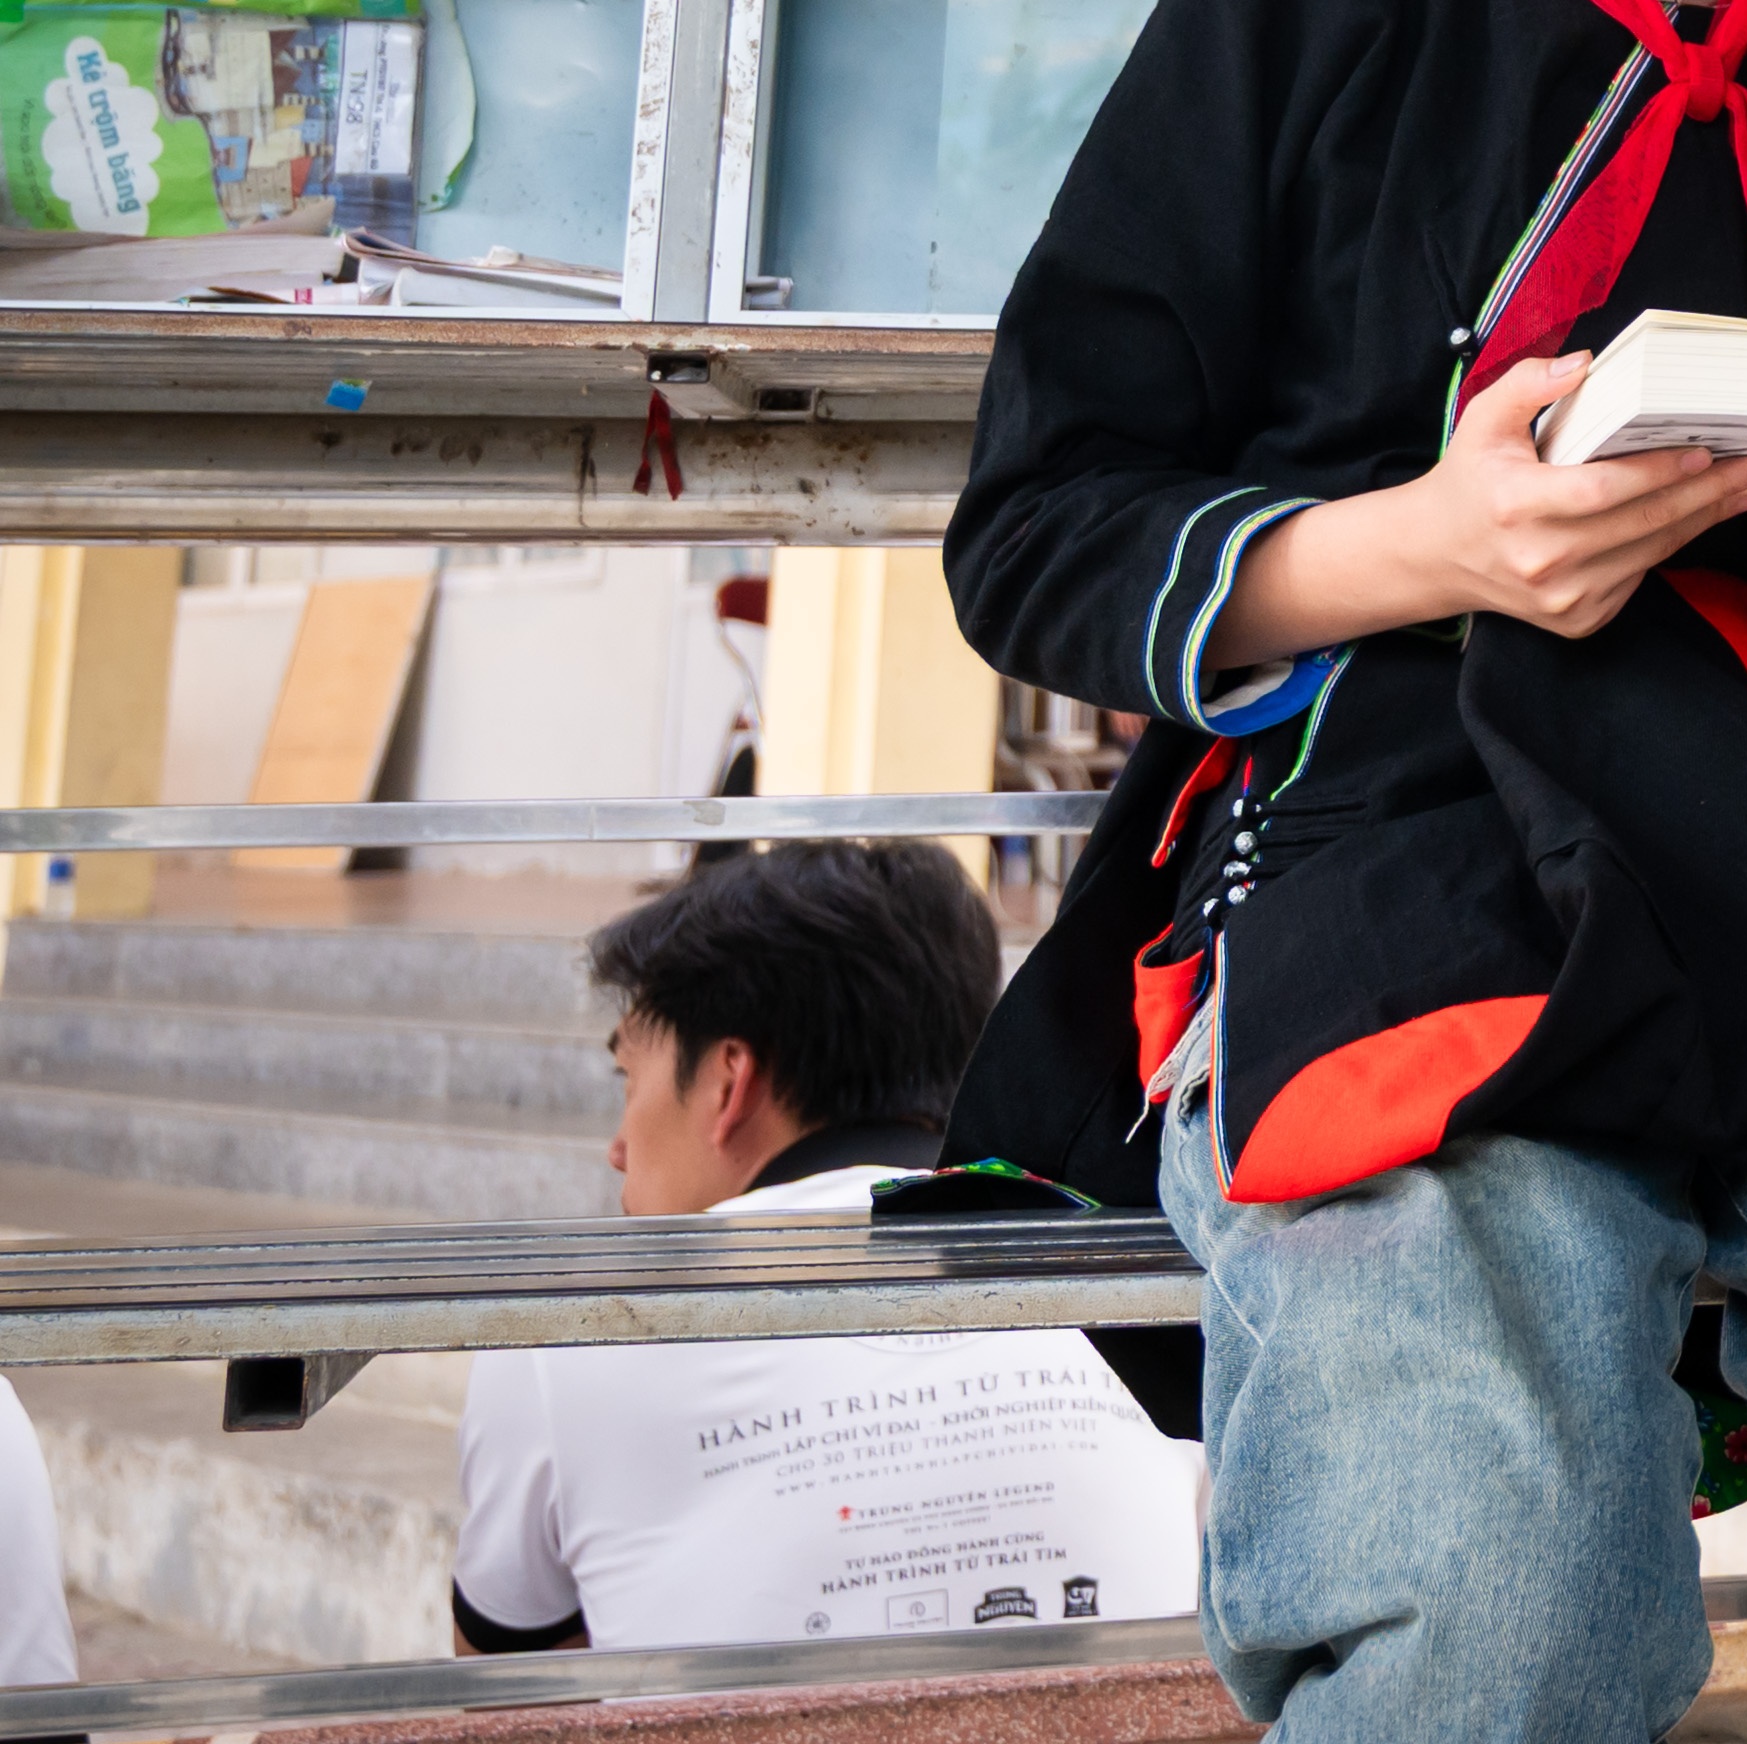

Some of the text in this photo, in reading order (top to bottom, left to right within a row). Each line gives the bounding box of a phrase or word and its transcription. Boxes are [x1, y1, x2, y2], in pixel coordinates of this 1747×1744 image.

[107, 151, 142, 214] băng
[698, 1406, 802, 1451] HÀNH
[820, 1384, 938, 1417] TRÌNH
[1014, 1364, 1087, 1387] TRÁI
[919, 1424, 995, 1453] THANH
[821, 1569, 879, 1595] HÀNH
[884, 1560, 947, 1583] TRÌNH
[985, 1546, 1029, 1567] TRÁI
[1034, 1546, 1069, 1564] TIM
